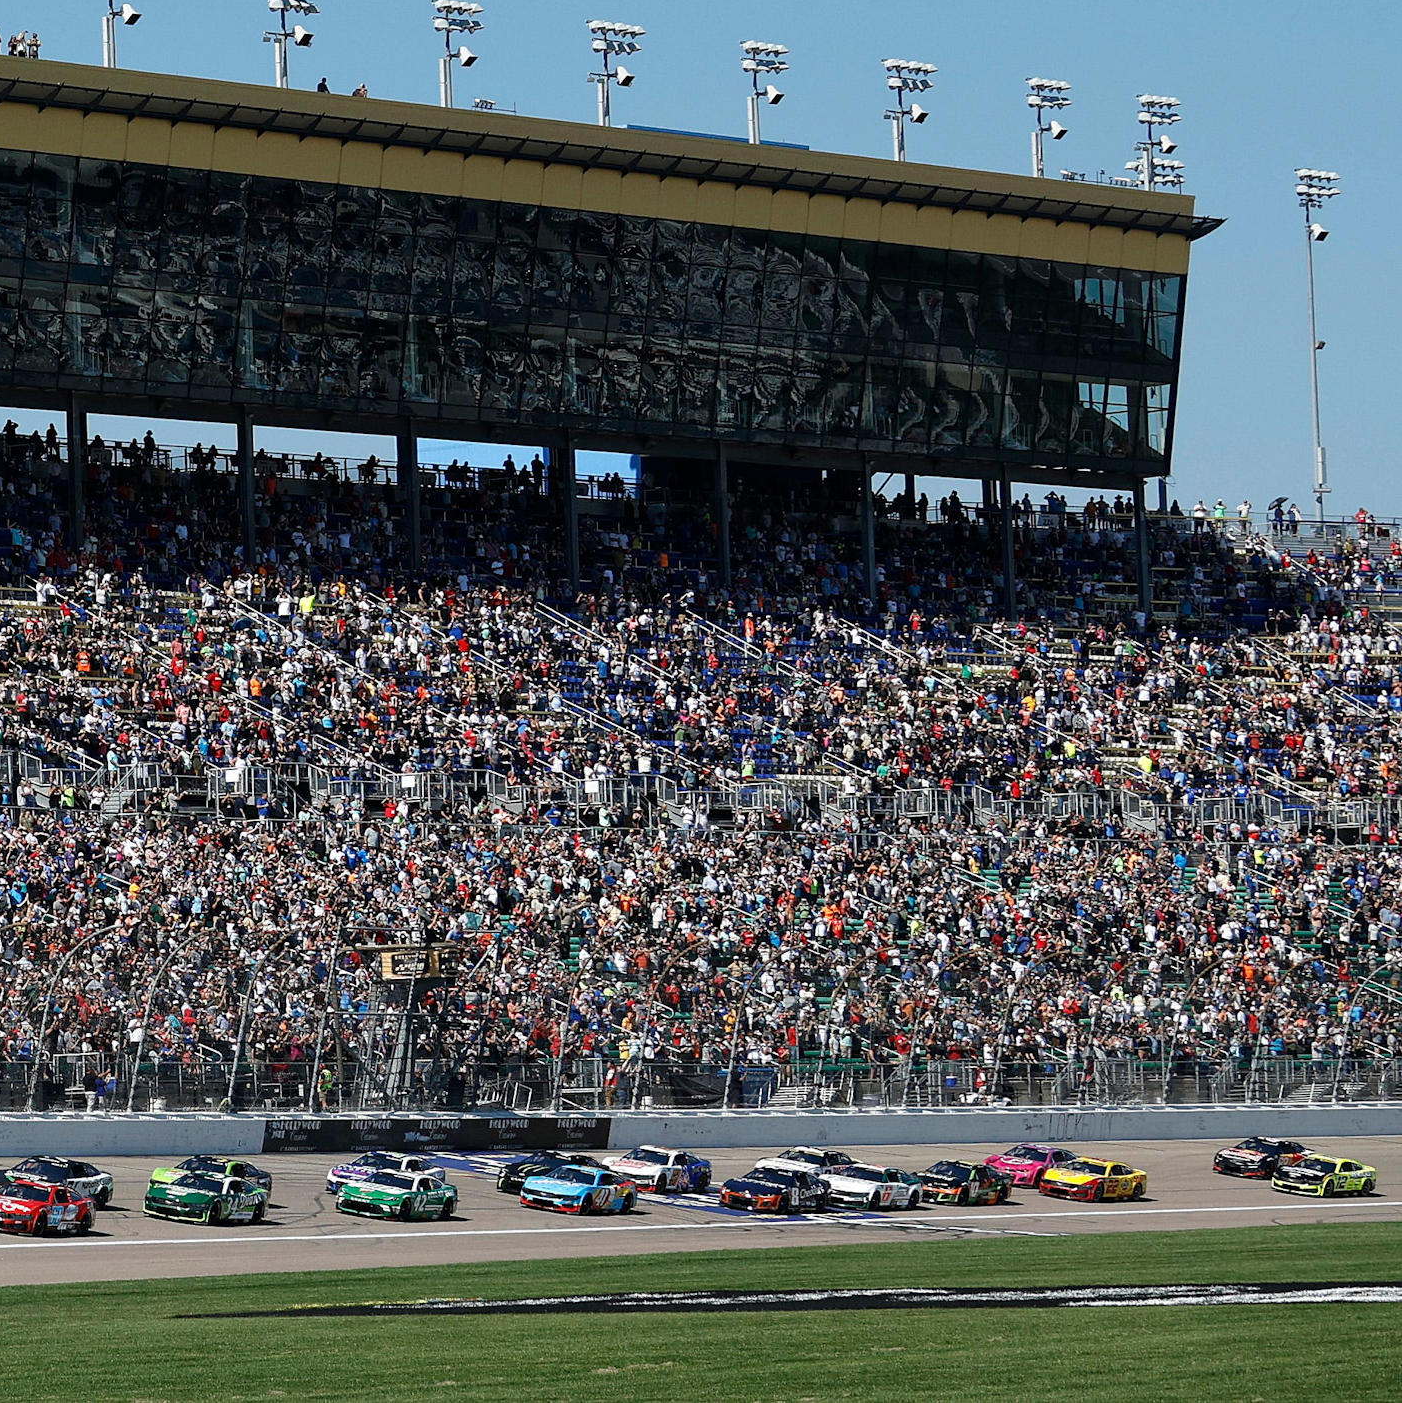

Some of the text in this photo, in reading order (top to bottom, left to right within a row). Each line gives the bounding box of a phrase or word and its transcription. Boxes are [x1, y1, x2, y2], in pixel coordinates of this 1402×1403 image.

[281, 1120, 322, 1130] HOLLYWOOD
[351, 1120, 392, 1130] HOLLYWOOD
[420, 1119, 461, 1129] HOLLYWOOD
[489, 1119, 530, 1128] HOLLYWOOD
[557, 1118, 597, 1128] HOLLYWOOD
[1106, 1179, 1119, 1194] 22
[1335, 1176, 1348, 1189] 12
[791, 1187, 799, 1205] 8
[225, 1197, 238, 1214] 34
[414, 1195, 427, 1212] 42
